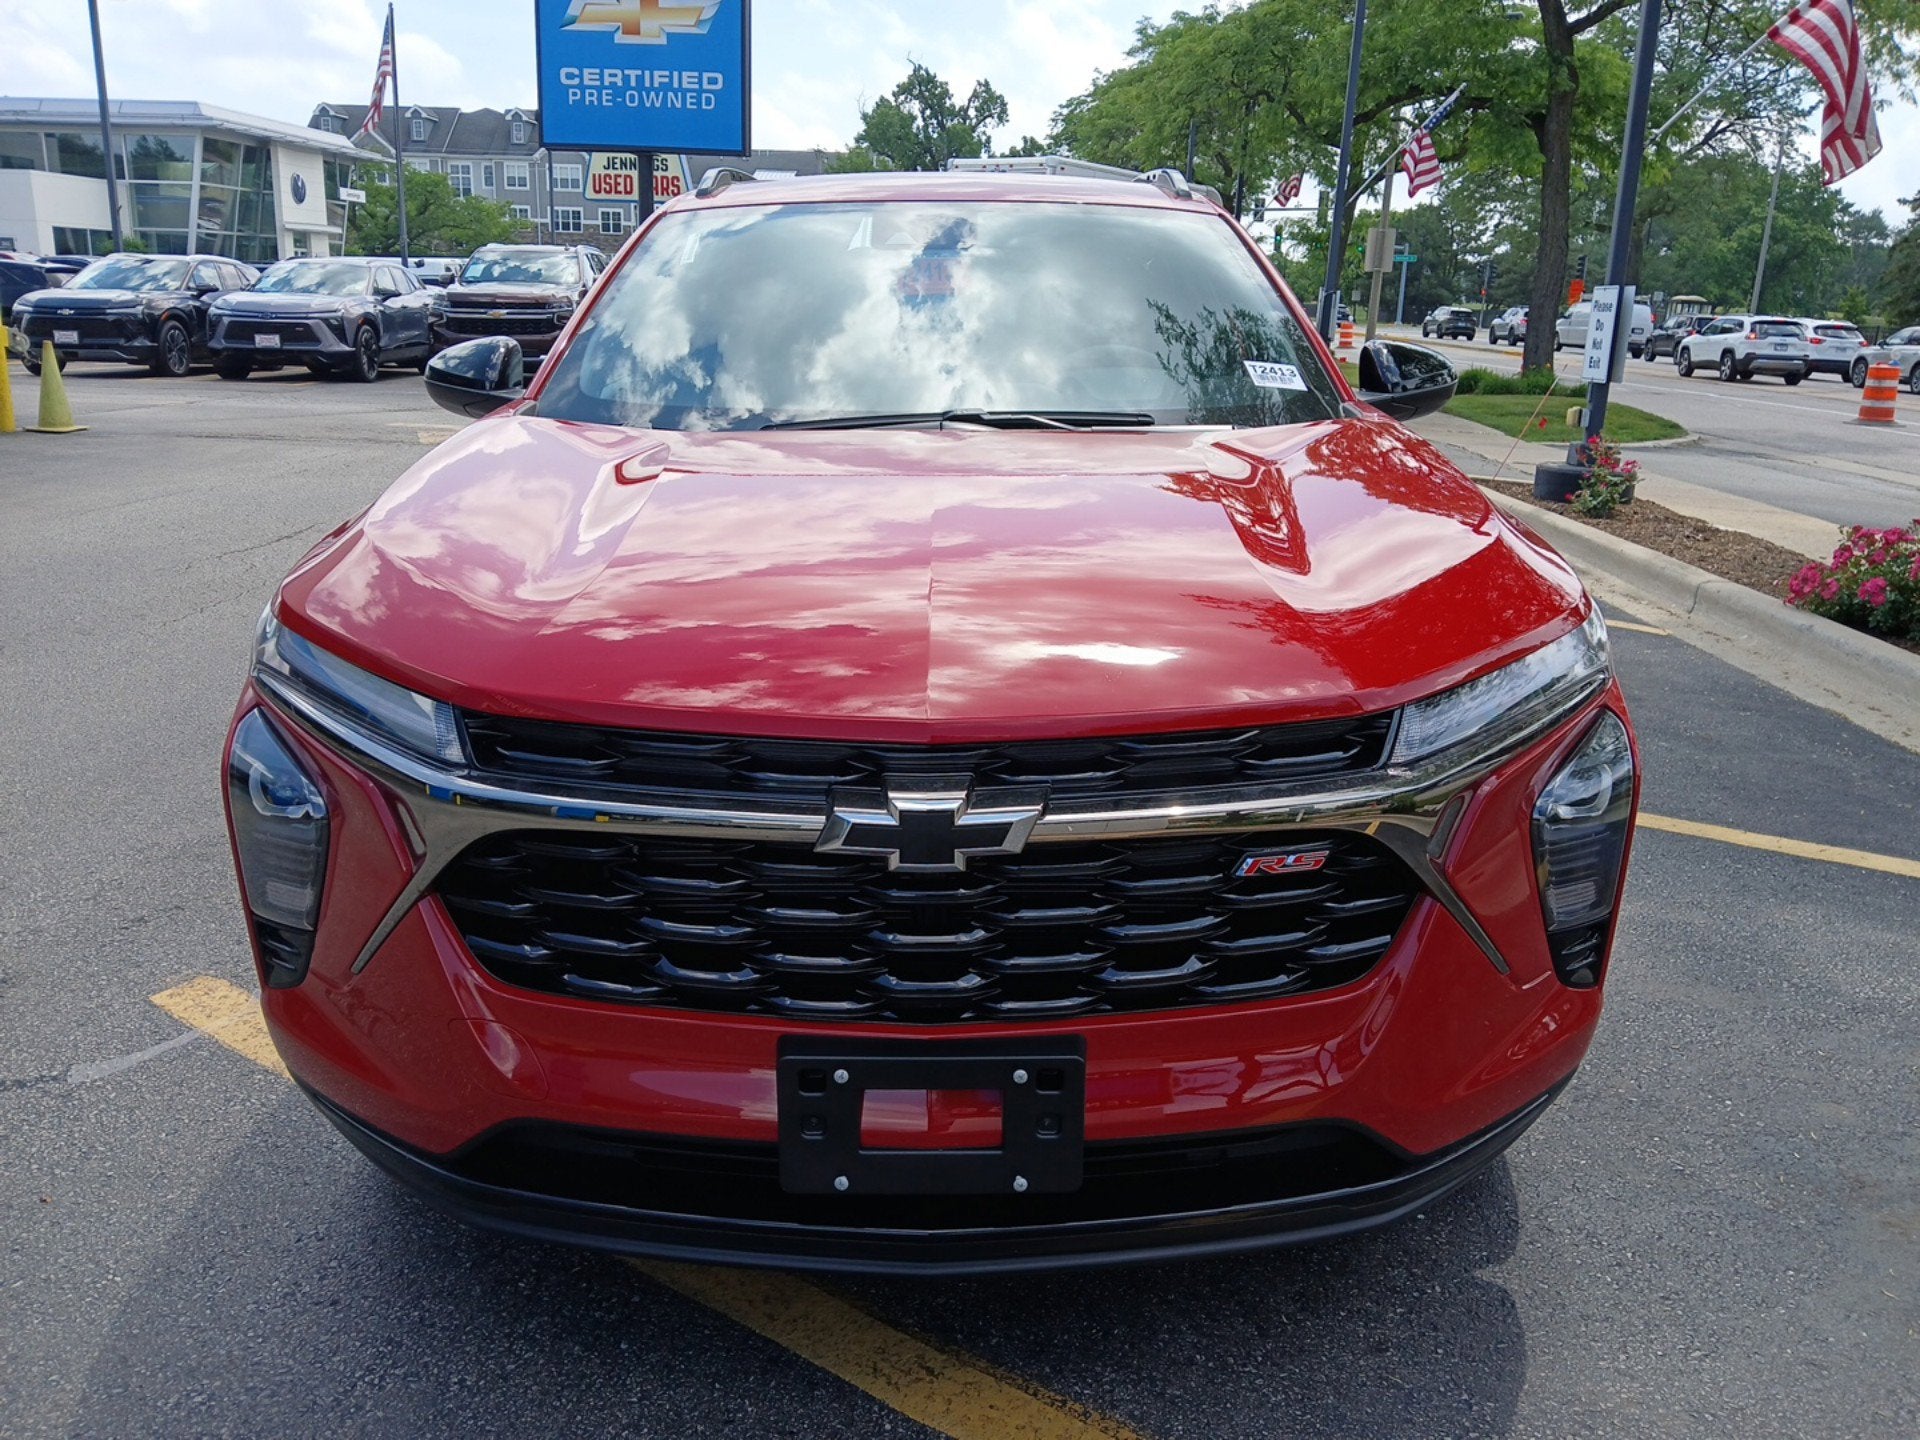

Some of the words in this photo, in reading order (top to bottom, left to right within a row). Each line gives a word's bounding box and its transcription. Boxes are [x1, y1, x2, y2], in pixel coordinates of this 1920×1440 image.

[559, 67, 724, 90] CERTIFIED
[568, 88, 716, 109] PRE-OWNED
[603, 156, 669, 172] JENNGS
[592, 173, 634, 195] USED
[650, 175, 681, 197] ARS
[1249, 364, 1297, 377] T2413
[1239, 850, 1330, 876] RS
